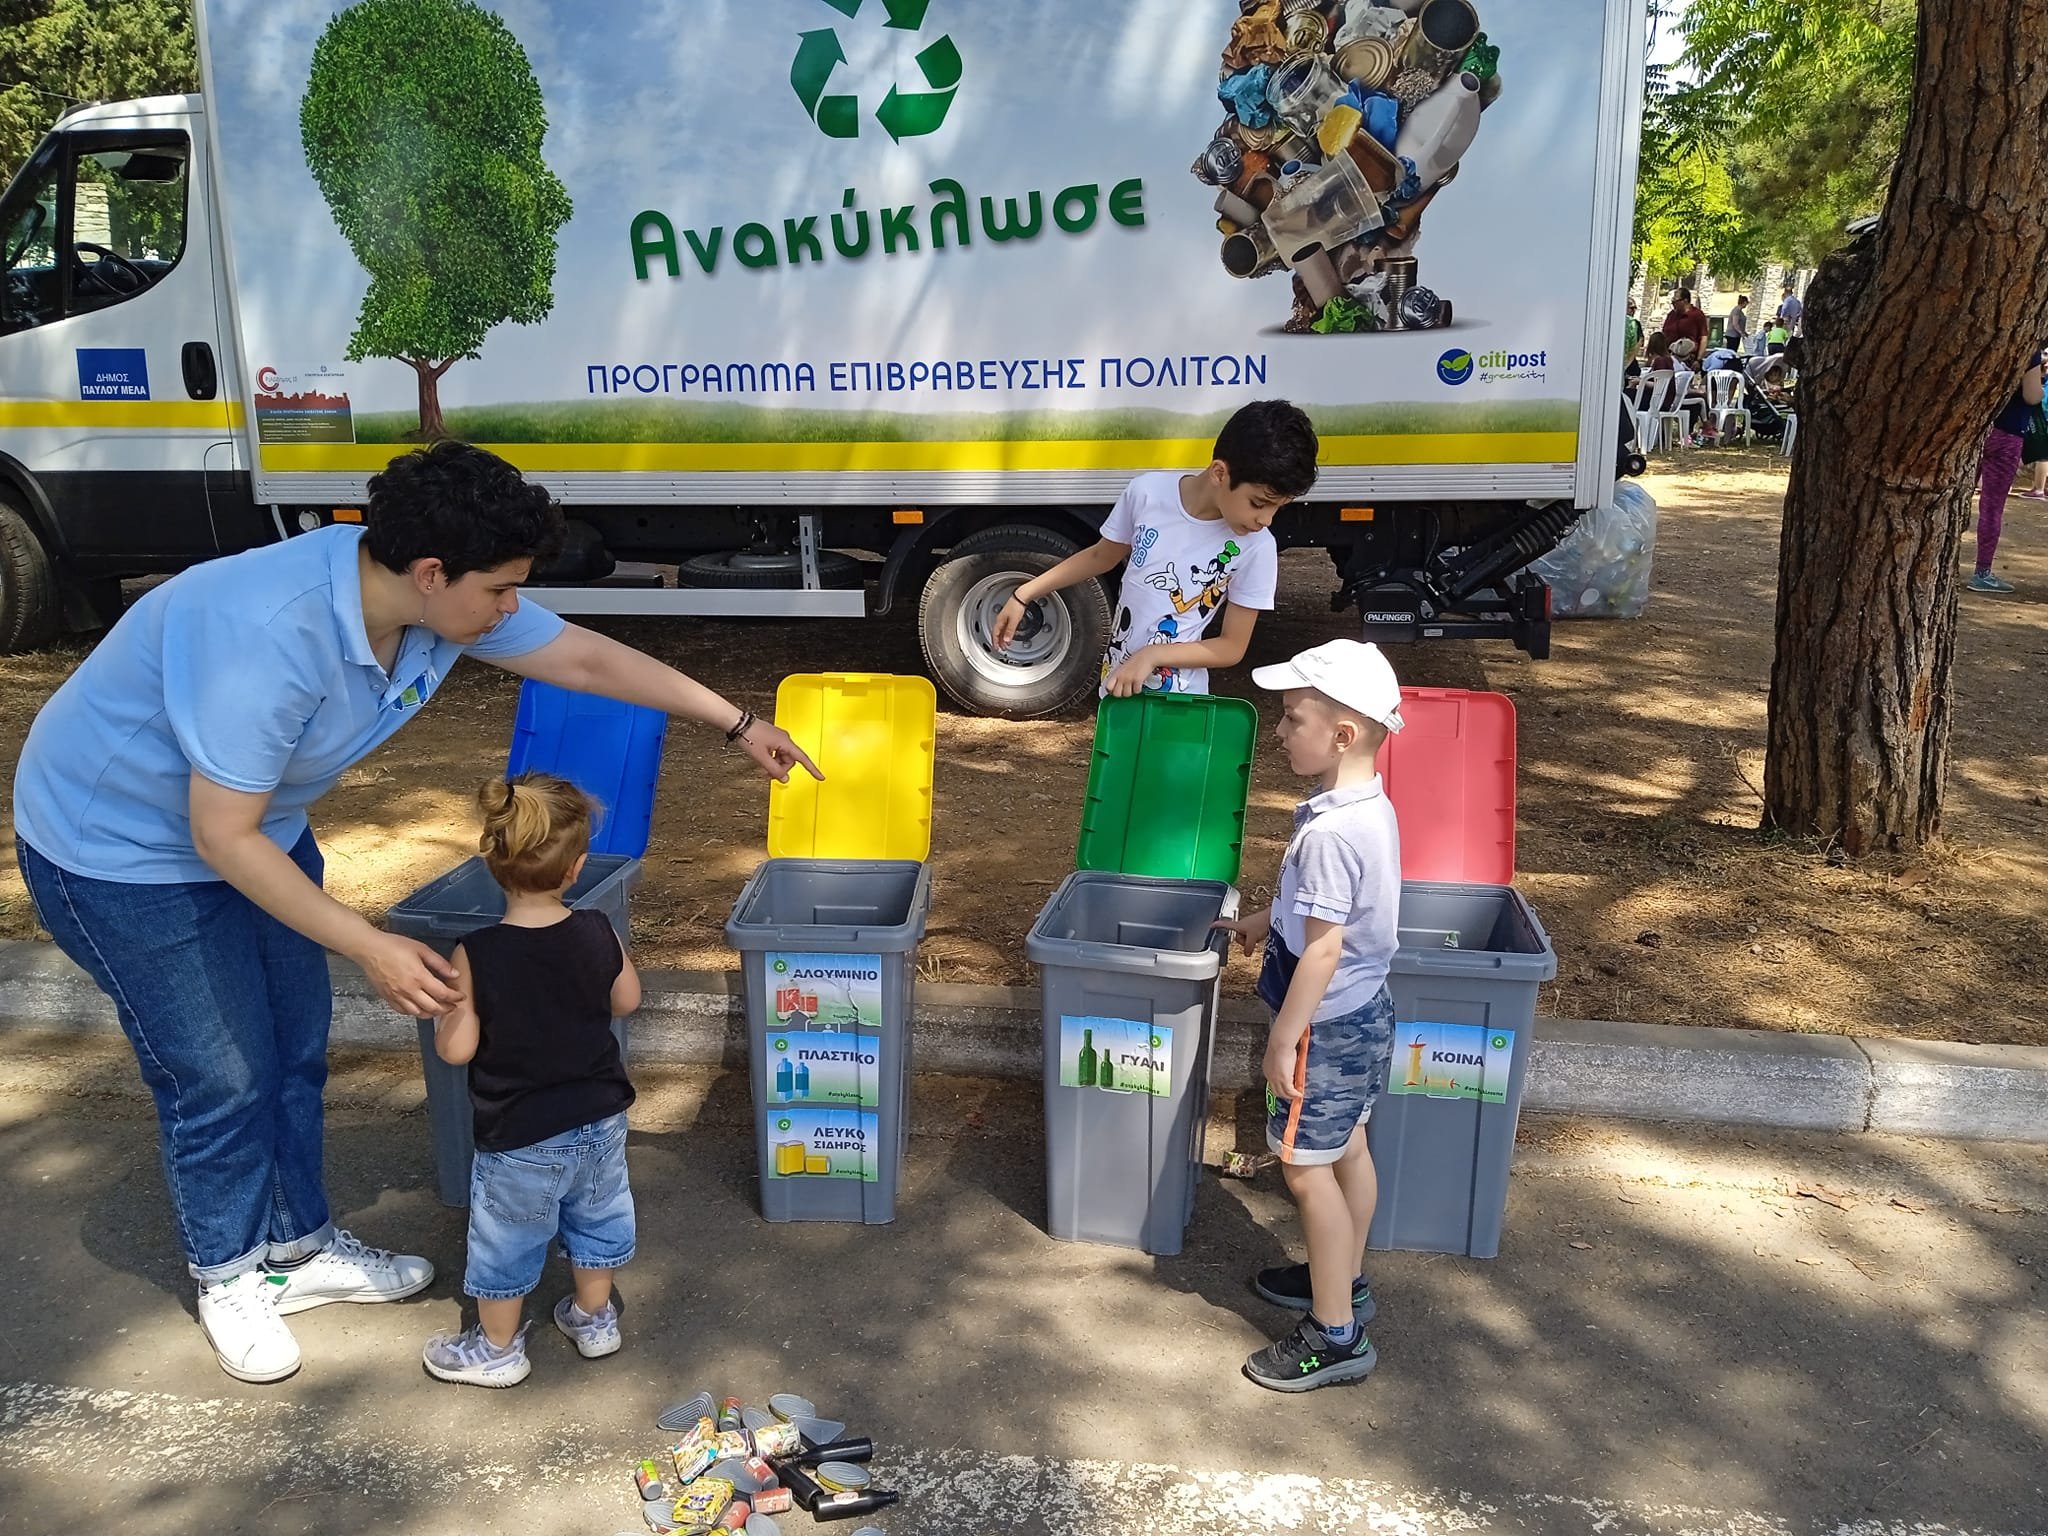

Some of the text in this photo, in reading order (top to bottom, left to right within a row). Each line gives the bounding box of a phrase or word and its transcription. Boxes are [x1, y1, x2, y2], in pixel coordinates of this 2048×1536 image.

[630, 177, 1145, 280] Ανακύκλωσε
[1478, 350, 1546, 371] citipost
[96, 373, 129, 382] ΔΗΜΟΣ
[587, 355, 1267, 393] ΠΡΟΓΡΑΜΜΑ ΕΠΙΒΡΑΒΕΥΣΗΣ ΠΟΛΙΤΩΝ
[82, 385, 146, 395] ΠΑΥΛΟΥ ΜΕΛΑ
[1367, 613, 1412, 622] PALFINGER
[793, 968, 878, 980] ΑΛΟΥΜΙΝΙΟ
[798, 1049, 875, 1065] ΠΛΑΣΤΙΚΟ
[1121, 1054, 1165, 1072] ΓΥΑΛΙ
[1432, 1051, 1485, 1067] ΚΟΙΝΑ
[814, 1127, 865, 1140] ΛΕΥΚΟ
[814, 1140, 867, 1153] ΣΙΔΗΡΟΣ
